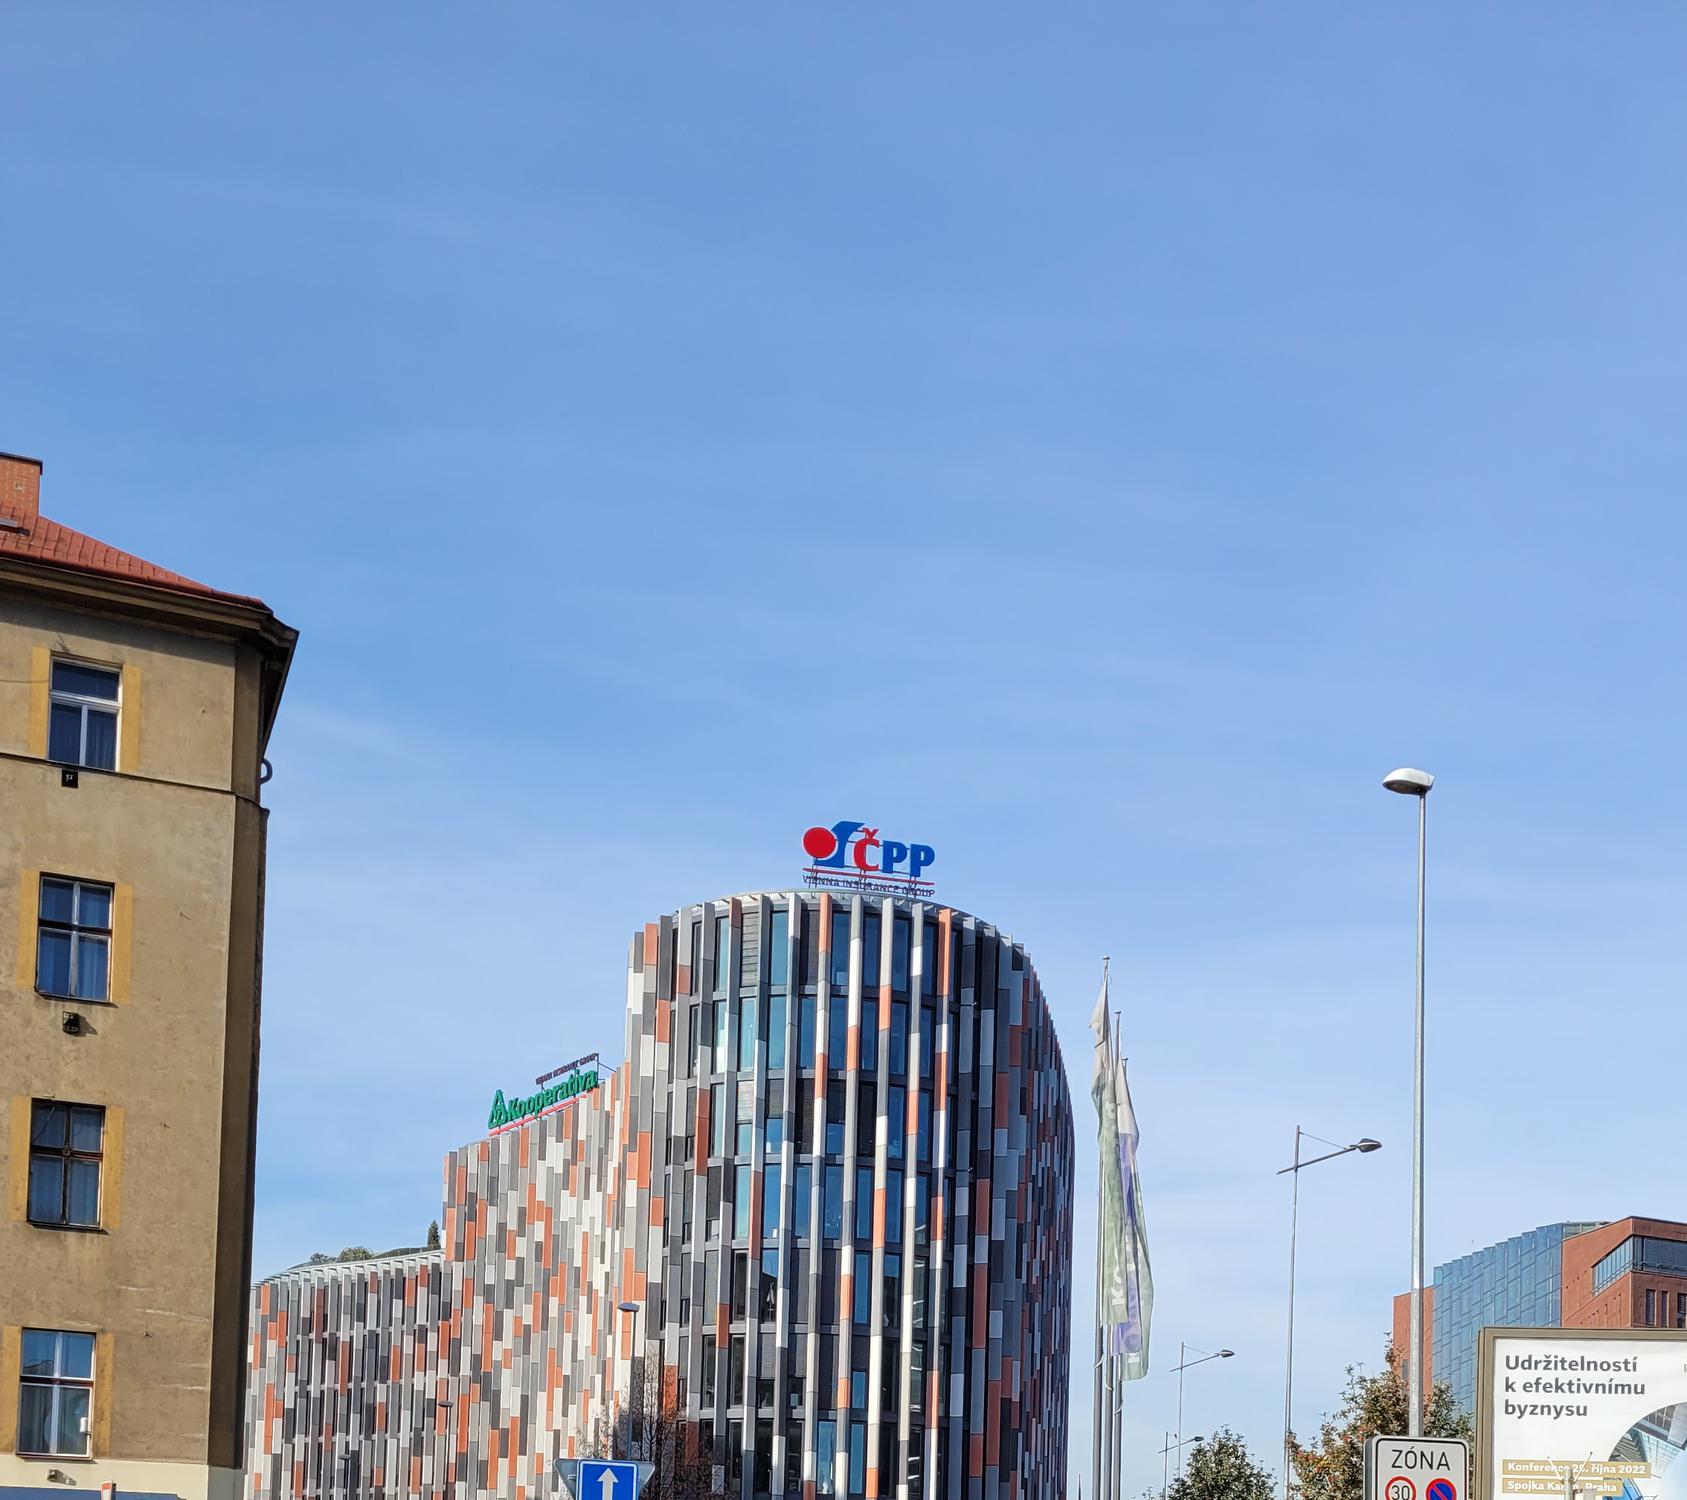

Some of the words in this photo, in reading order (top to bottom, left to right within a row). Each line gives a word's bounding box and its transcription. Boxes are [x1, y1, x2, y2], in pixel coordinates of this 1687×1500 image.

[853, 827, 936, 877] ČPP
[507, 1068, 599, 1121] Kooperativa
[1505, 1354, 1638, 1373] Udržitelností
[1505, 1376, 1516, 1393] k
[1522, 1377, 1646, 1395] efektivnímu
[1504, 1399, 1588, 1420] byznysu
[1391, 1446, 1451, 1471] ZÓNA
[1591, 1463, 1616, 1475] října
[1618, 1465, 1646, 1474] 2022
[1507, 1480, 1545, 1491] Spojka
